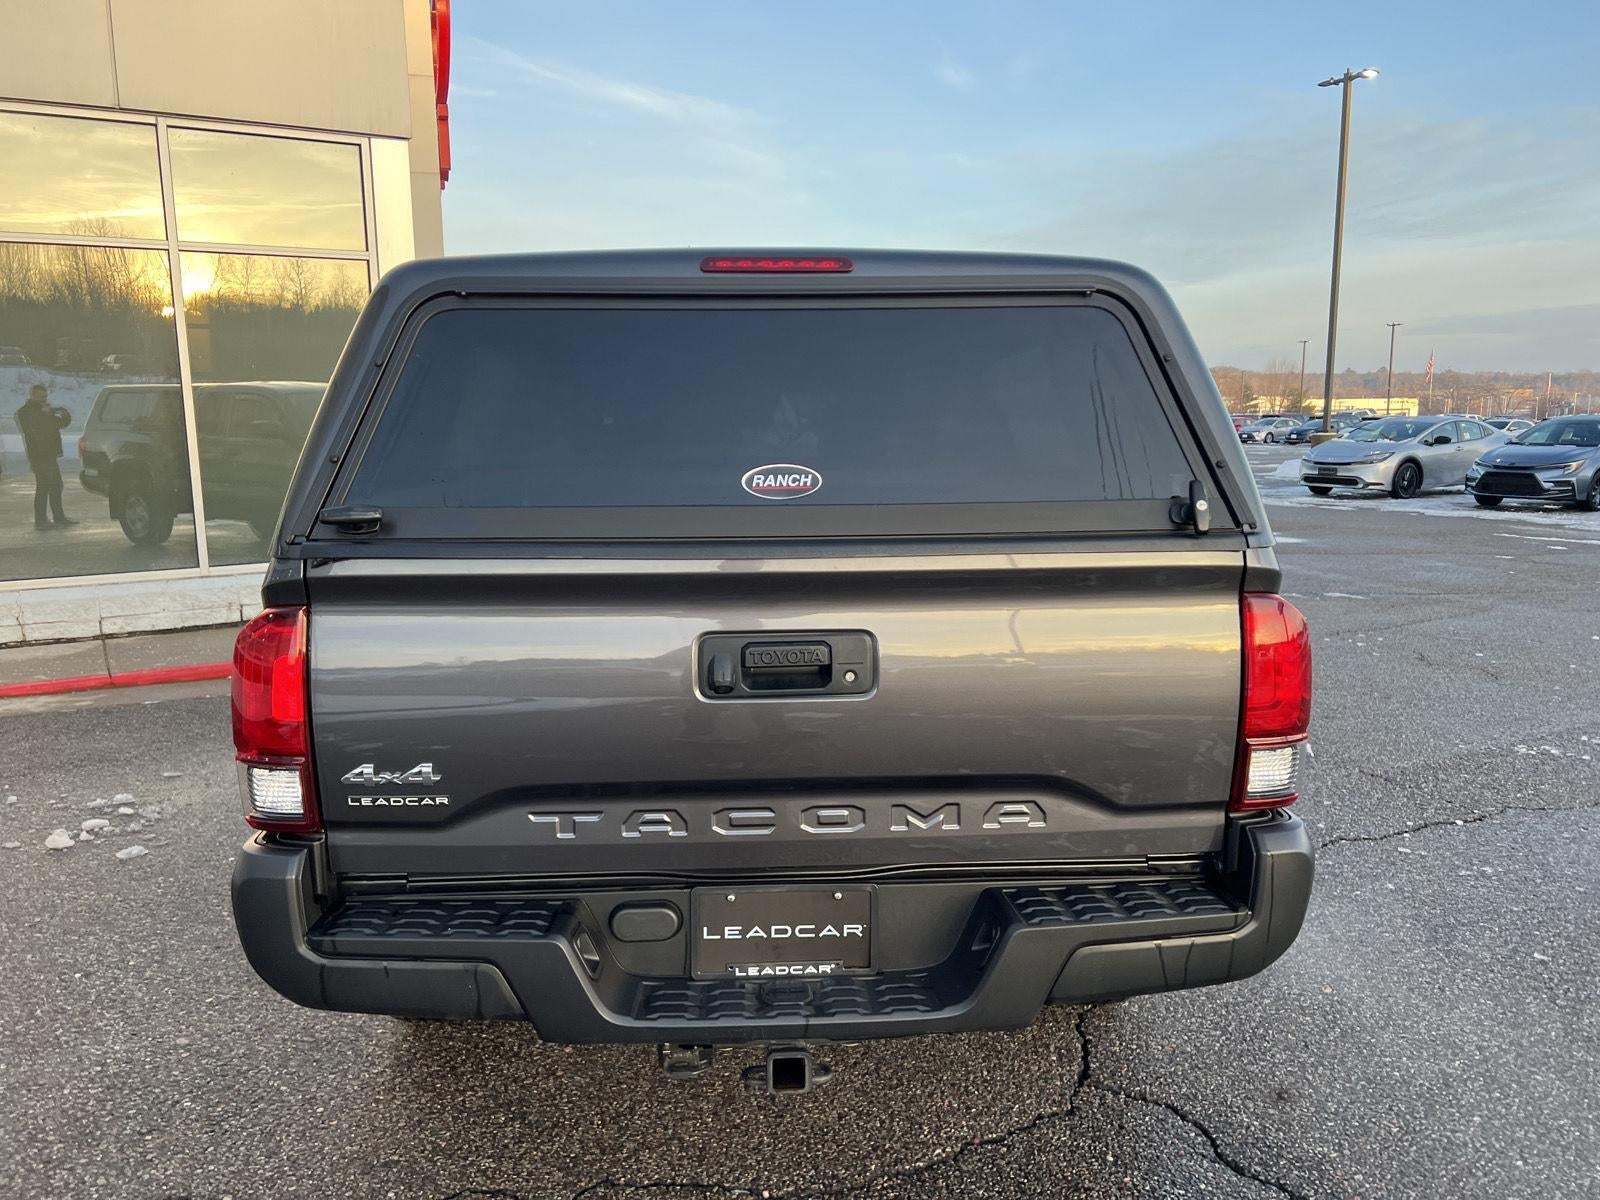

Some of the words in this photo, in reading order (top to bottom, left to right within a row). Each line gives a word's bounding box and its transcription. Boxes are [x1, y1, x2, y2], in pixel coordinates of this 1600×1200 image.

[752, 474, 813, 488] RANCH
[750, 649, 824, 665] TOYOTA
[347, 797, 449, 806] LEADCAR
[527, 800, 1048, 839] TACOMA
[703, 924, 866, 940] LEADCAR
[735, 964, 834, 977] LEADCAR
